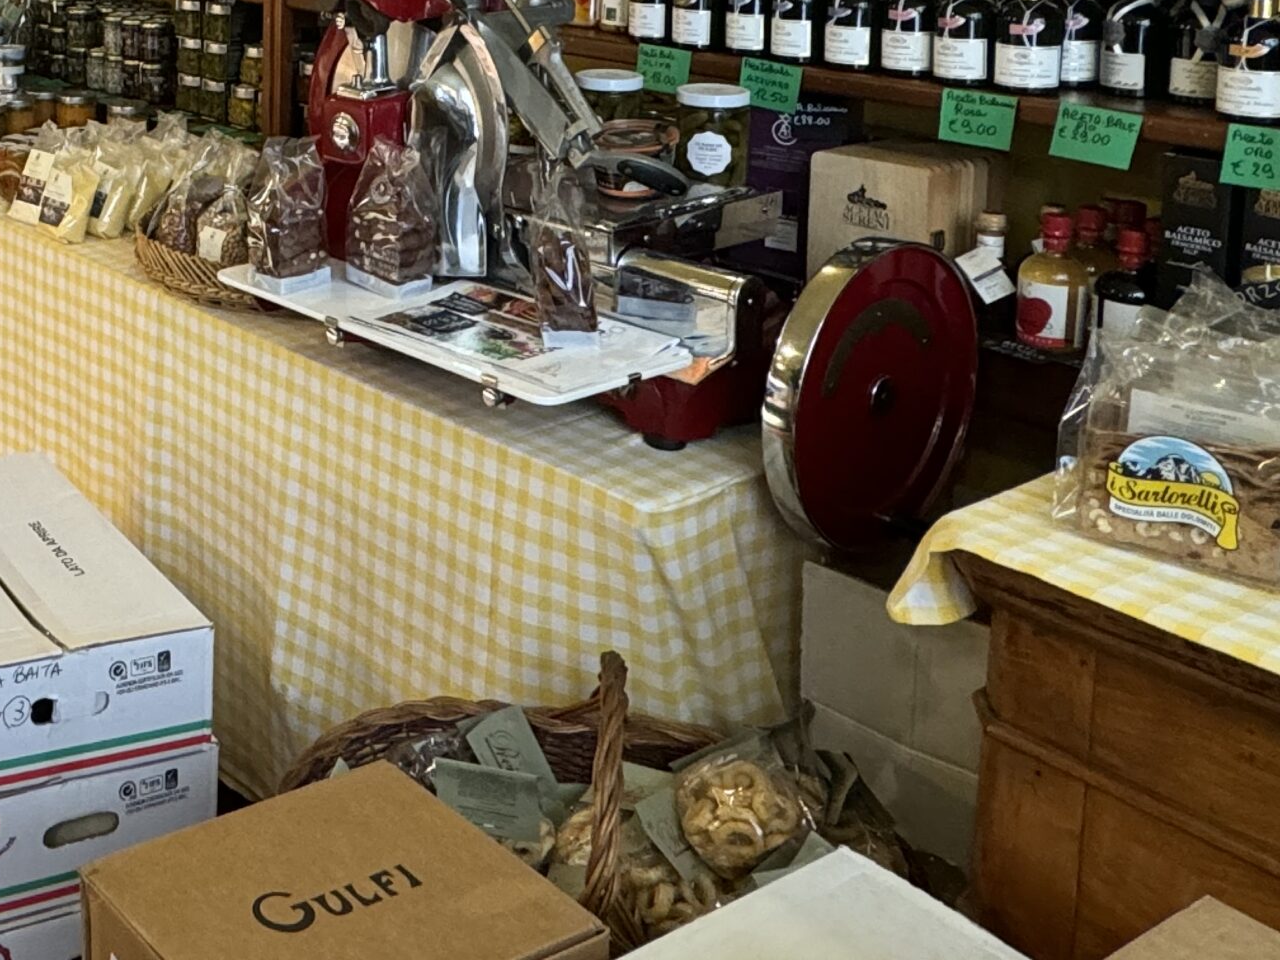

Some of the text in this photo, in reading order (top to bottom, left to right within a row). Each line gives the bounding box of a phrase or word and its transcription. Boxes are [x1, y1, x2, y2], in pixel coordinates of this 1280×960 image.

[1164, 230, 1222, 248] BALSAMICO
[1176, 225, 1211, 237] ACETO
[13, 661, 63, 684] BAITA
[252, 864, 423, 933] GULFI
